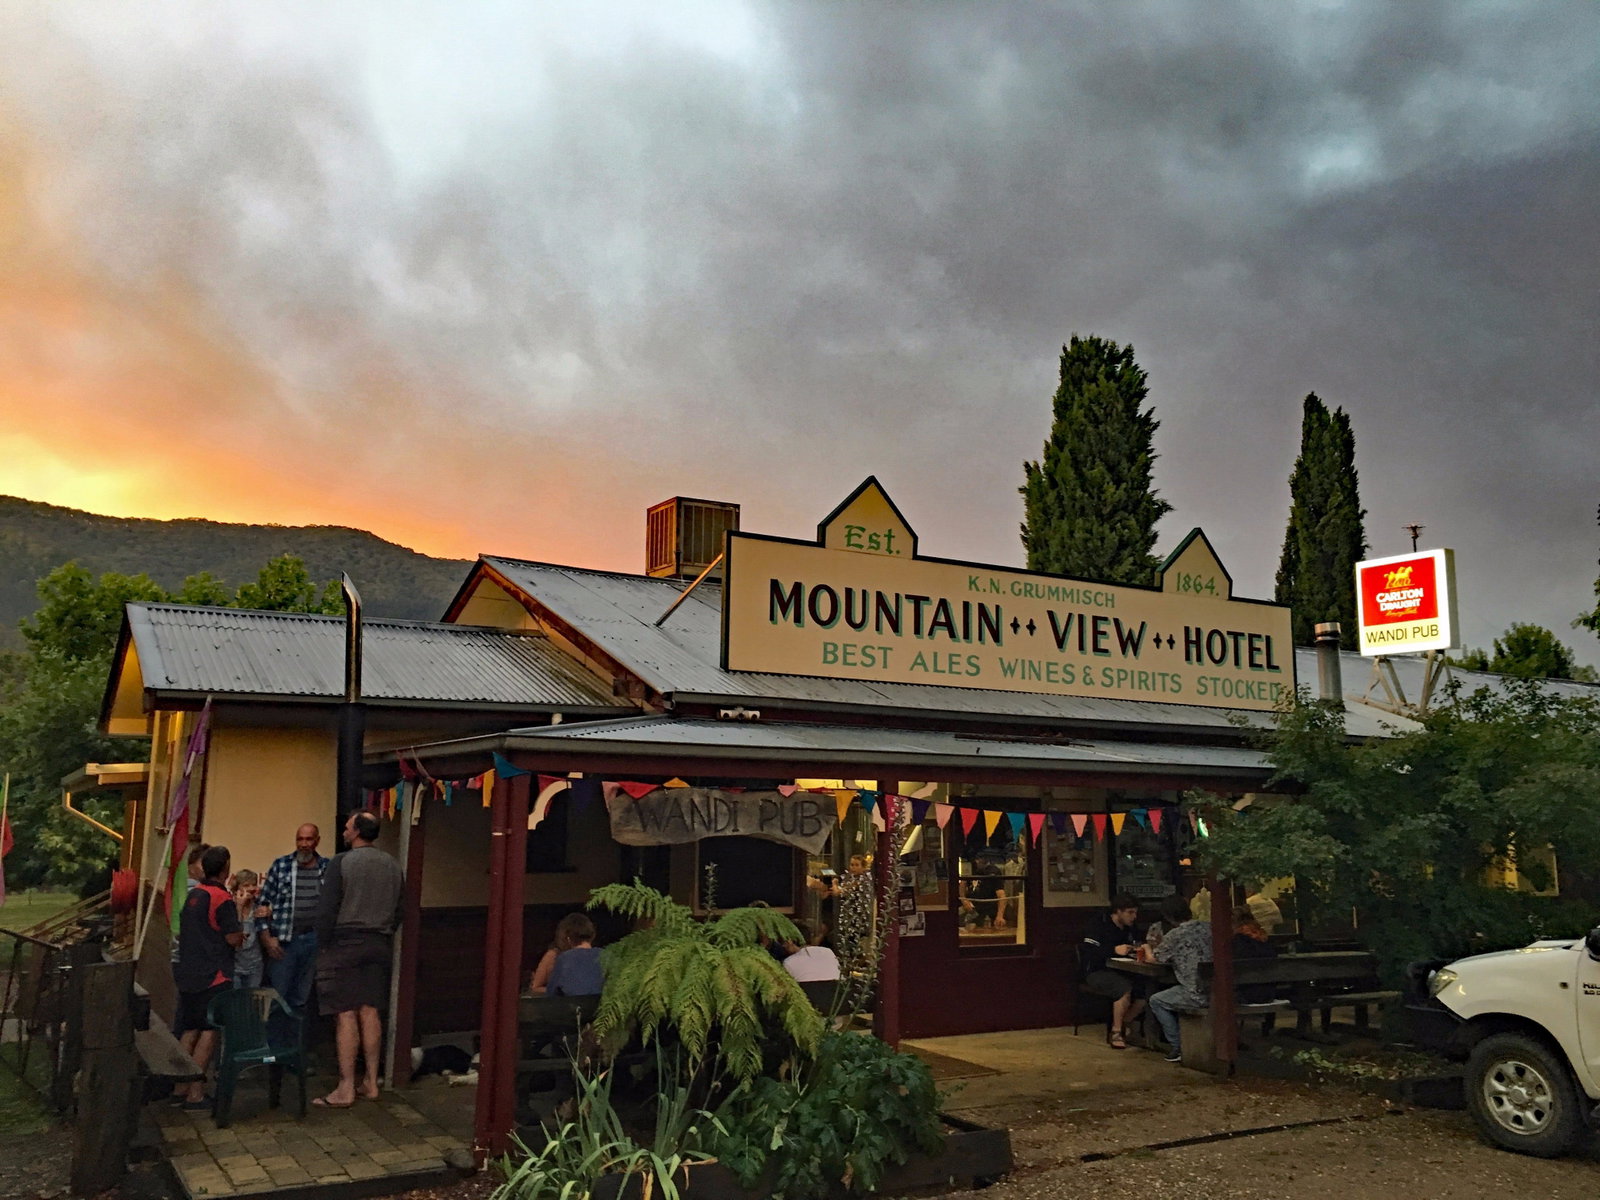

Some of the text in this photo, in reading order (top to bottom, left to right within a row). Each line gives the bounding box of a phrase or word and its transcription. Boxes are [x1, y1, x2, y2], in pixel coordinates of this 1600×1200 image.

[845, 525, 900, 554] Est.
[1010, 580, 1115, 608] GRUMMISCH
[1376, 587, 1424, 603] CARLTON
[769, 578, 1282, 673] MOUNTAIN VIEW HOTEL
[1366, 624, 1439, 643] WANDI PUB
[822, 641, 1280, 702] BEST ALES WINES & SPIRITS STOCKED
[633, 796, 823, 837] WANDI PUB
